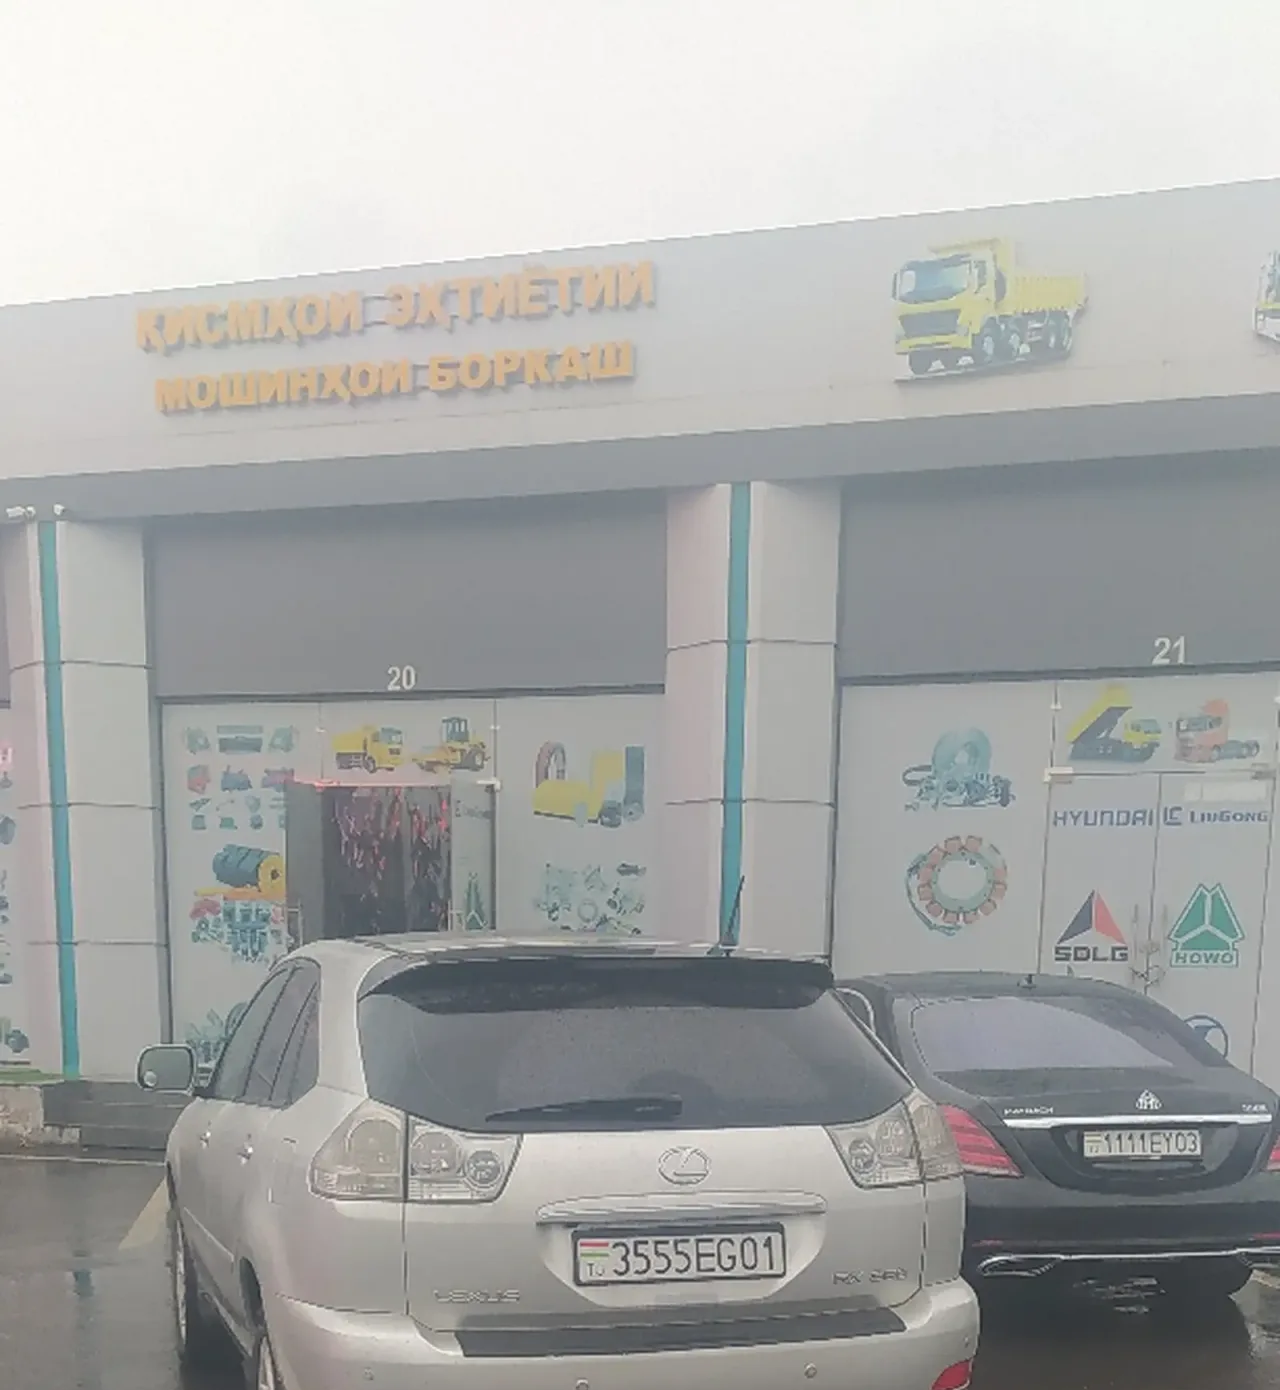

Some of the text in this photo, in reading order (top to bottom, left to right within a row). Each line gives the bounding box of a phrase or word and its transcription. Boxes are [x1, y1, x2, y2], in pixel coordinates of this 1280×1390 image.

[427, 339, 635, 393] БОРКАШ
[1152, 635, 1185, 665] 21
[387, 665, 416, 691] 20
[1053, 809, 1153, 827] HYUNDAI
[1054, 946, 1128, 962] SDLG
[1175, 951, 1234, 964] HOWO
[1104, 1131, 1199, 1154] 1111EY03
[611, 1236, 775, 1277] 3555EG01
